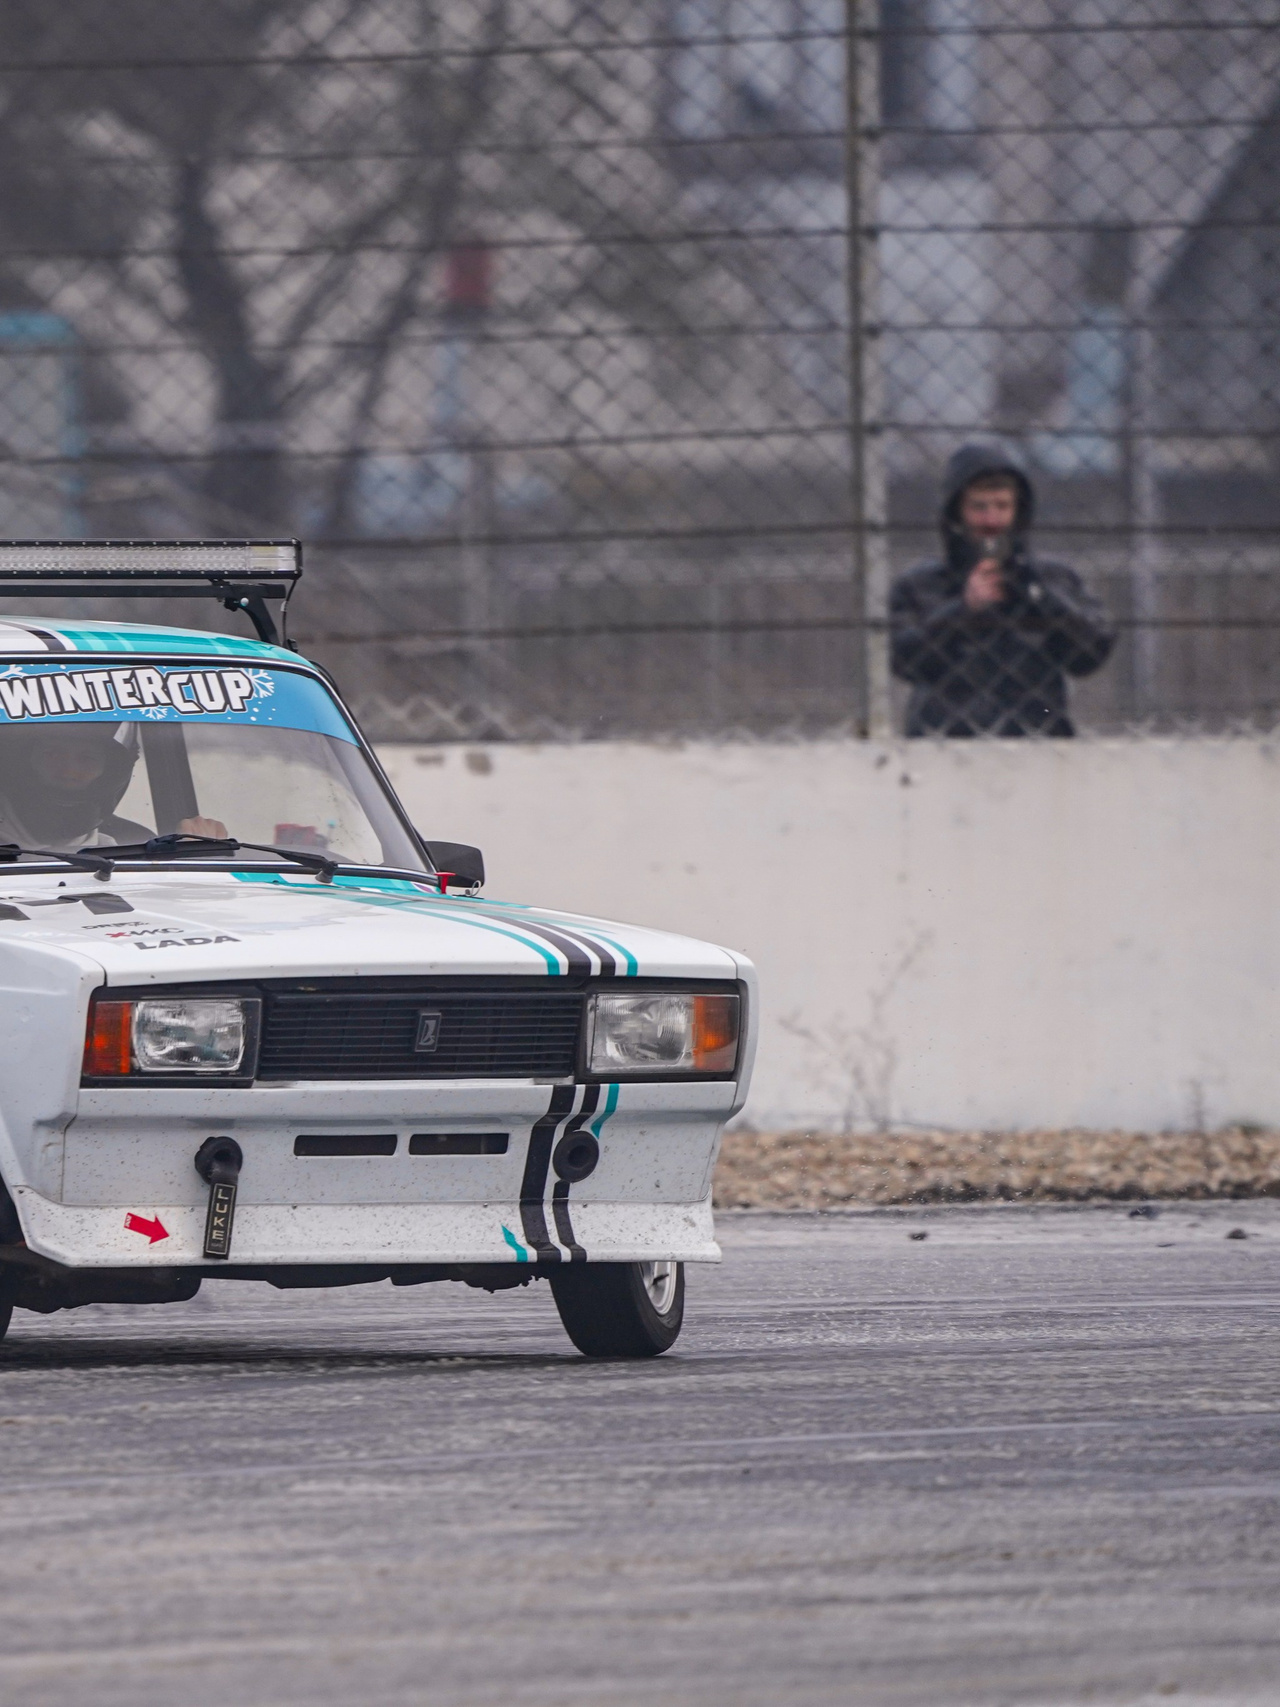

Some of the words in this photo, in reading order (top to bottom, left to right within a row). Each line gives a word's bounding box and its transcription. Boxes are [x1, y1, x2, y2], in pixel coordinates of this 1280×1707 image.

[166, 671, 253, 713] CUP
[133, 935, 242, 950] LADA
[212, 1188, 230, 1241] LUKE
